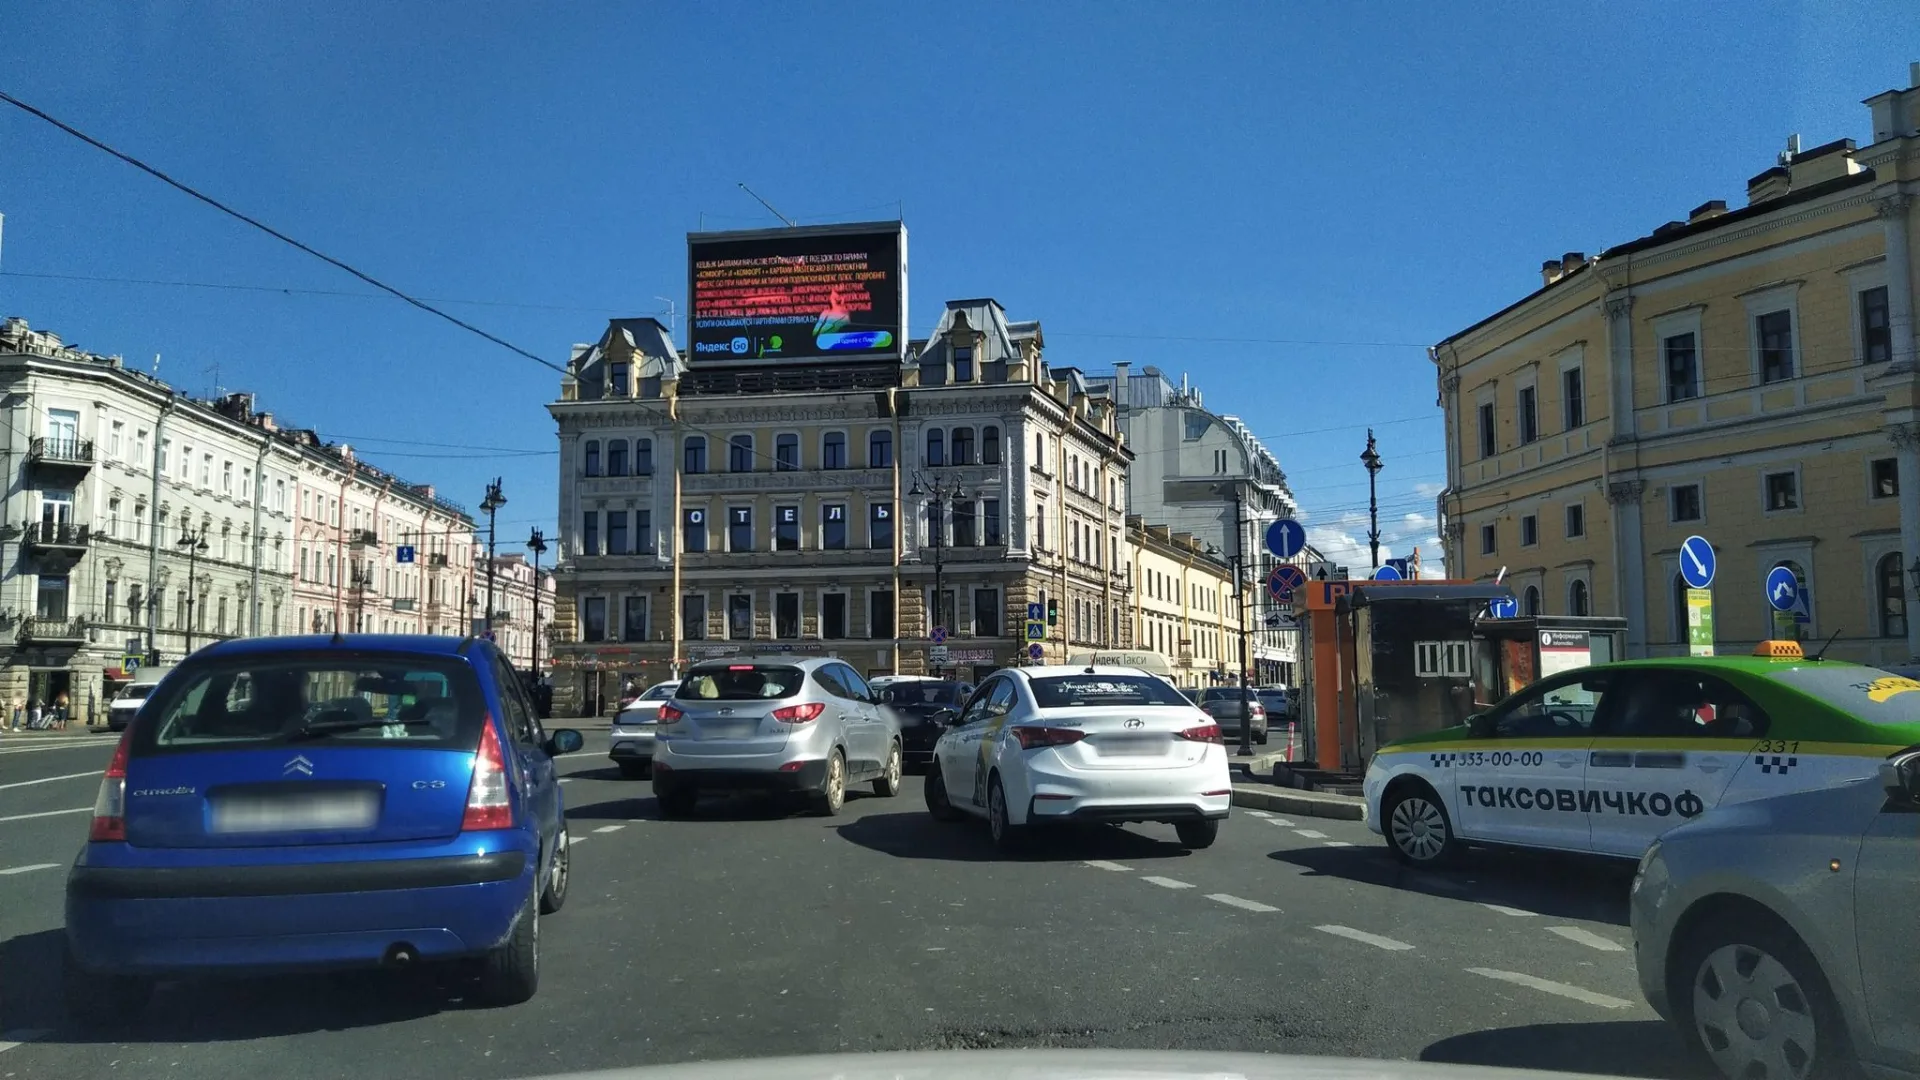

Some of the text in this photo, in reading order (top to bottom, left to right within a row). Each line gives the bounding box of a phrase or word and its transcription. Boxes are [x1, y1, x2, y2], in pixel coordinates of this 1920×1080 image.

[695, 341, 747, 352] Яндекс Go
[690, 506, 888, 523] ОТЕЛЬ
[1552, 632, 1583, 640] Информация
[1090, 653, 1147, 665] Яндекс Такси
[1758, 739, 1800, 754] 331
